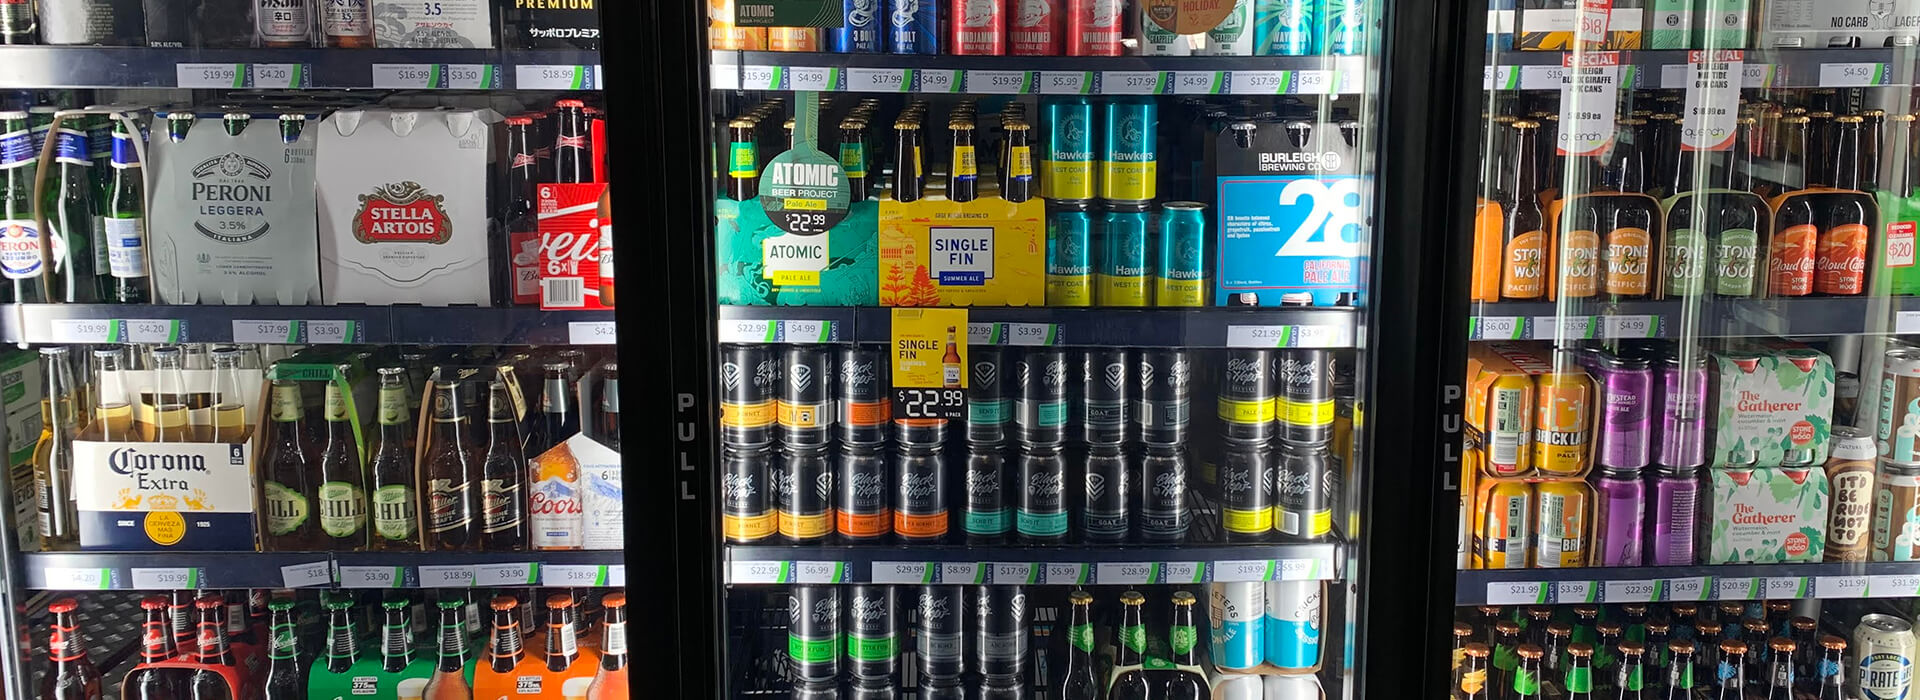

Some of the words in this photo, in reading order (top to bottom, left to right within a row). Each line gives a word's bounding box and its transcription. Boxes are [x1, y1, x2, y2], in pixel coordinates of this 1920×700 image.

[424, 3, 442, 16] 3.5
[515, 0, 593, 10] PREMIUM
[740, 5, 774, 17] ATOMIC
[1831, 17, 1844, 27] NO
[1846, 17, 1868, 27] CARB
[529, 28, 600, 38] サッポロプレミア
[204, 70, 235, 80] $19.99
[259, 70, 285, 80] $4.20
[398, 71, 429, 80] $16.99
[451, 71, 477, 80] $3.50
[542, 70, 573, 79] $18.99
[798, 73, 823, 82] $4.99
[1843, 68, 1868, 77] $4.50
[872, 75, 902, 84] $17.99
[922, 76, 947, 85] $4.99
[992, 76, 1023, 86] $19.99
[1053, 77, 1078, 86] $5.99
[1127, 77, 1157, 86] $17.99
[1183, 77, 1208, 86] $4.99
[1250, 77, 1281, 86] $17.99
[1301, 76, 1321, 86] $4.9
[1586, 76, 1612, 84] GIRAFFE
[1586, 85, 1602, 93] CANS
[1262, 153, 1321, 163] BURLEIGH
[1262, 164, 1304, 172] BREWING
[772, 162, 839, 187] ATOMIC
[192, 182, 272, 202] PERONI
[540, 187, 550, 199] 6
[772, 188, 796, 196] BEER
[798, 189, 838, 198] PROJECT
[786, 200, 803, 208] Pale
[805, 200, 817, 208] Ale
[200, 205, 265, 216] LEGGERA
[371, 208, 433, 220] STELLA
[786, 213, 826, 233] $22.99
[1275, 179, 1371, 259] 28
[219, 221, 247, 231] 3.5%
[371, 222, 435, 234] ARTOIS
[935, 239, 988, 251] SINGLE
[1889, 242, 1911, 258] $20
[770, 245, 823, 259] ATOMIC
[1608, 244, 1648, 258] STONE
[950, 253, 974, 265] FIN
[1771, 257, 1800, 271] Cloud
[1817, 257, 1849, 271] Cloud
[1608, 262, 1647, 276] WOOD
[1304, 272, 1328, 283] PALE
[78, 324, 108, 334] $19.99
[139, 324, 165, 334] $4.20
[258, 325, 289, 334] $17.99
[314, 325, 340, 335] $3.90
[738, 324, 767, 333] $22.99
[791, 324, 816, 333] $4.99
[1485, 321, 1510, 331] $6.00
[1620, 321, 1645, 331] $4.99
[967, 327, 992, 336] 22.99
[1018, 327, 1043, 336] $3.99
[1251, 328, 1282, 338] $21.99
[899, 340, 939, 350] SINGLE
[899, 351, 917, 360] FIN
[1739, 390, 1760, 401] The
[898, 390, 963, 417] $22.99
[1737, 400, 1802, 413] Gatherer
[1443, 385, 1462, 491] PULL
[677, 393, 696, 501] PULL
[233, 448, 240, 457] 6
[109, 447, 207, 475] Corona
[602, 471, 608, 480] 6
[138, 473, 189, 490] Extra
[1840, 475, 1867, 489] IT'D
[1838, 489, 1858, 503] BE
[530, 492, 583, 514] Coors
[1733, 503, 1755, 514] The
[1836, 503, 1870, 516] RUDE
[1732, 513, 1796, 525] Gatherer
[1833, 516, 1865, 528] NOT
[1834, 528, 1856, 541] TO
[1786, 536, 1806, 544] STONE
[1786, 544, 1806, 552] WOOD
[499, 568, 525, 578] $3.90
[750, 565, 780, 575] $22.99
[805, 565, 830, 575] $6.99
[895, 565, 926, 575] $29.99
[947, 565, 972, 575] $8.99
[1000, 567, 1030, 577] $17.99
[1051, 567, 1076, 577] $5.99
[1121, 567, 1151, 577] $28.99
[1167, 566, 1192, 576] $7.99
[1237, 564, 1267, 575] $19.99
[158, 573, 188, 583] $19.99
[364, 571, 390, 581] $3.90
[443, 571, 474, 580] $18.99
[567, 571, 598, 581] $18.99
[1674, 582, 1699, 592] $4.99
[1721, 581, 1751, 591] $20.99
[1770, 580, 1795, 590] $5.99
[1838, 578, 1867, 588] $11.99
[1510, 585, 1540, 595] $21.99
[1560, 585, 1584, 594] $3.99
[1624, 585, 1654, 595] $22.99
[1859, 668, 1899, 688] PIRATE
